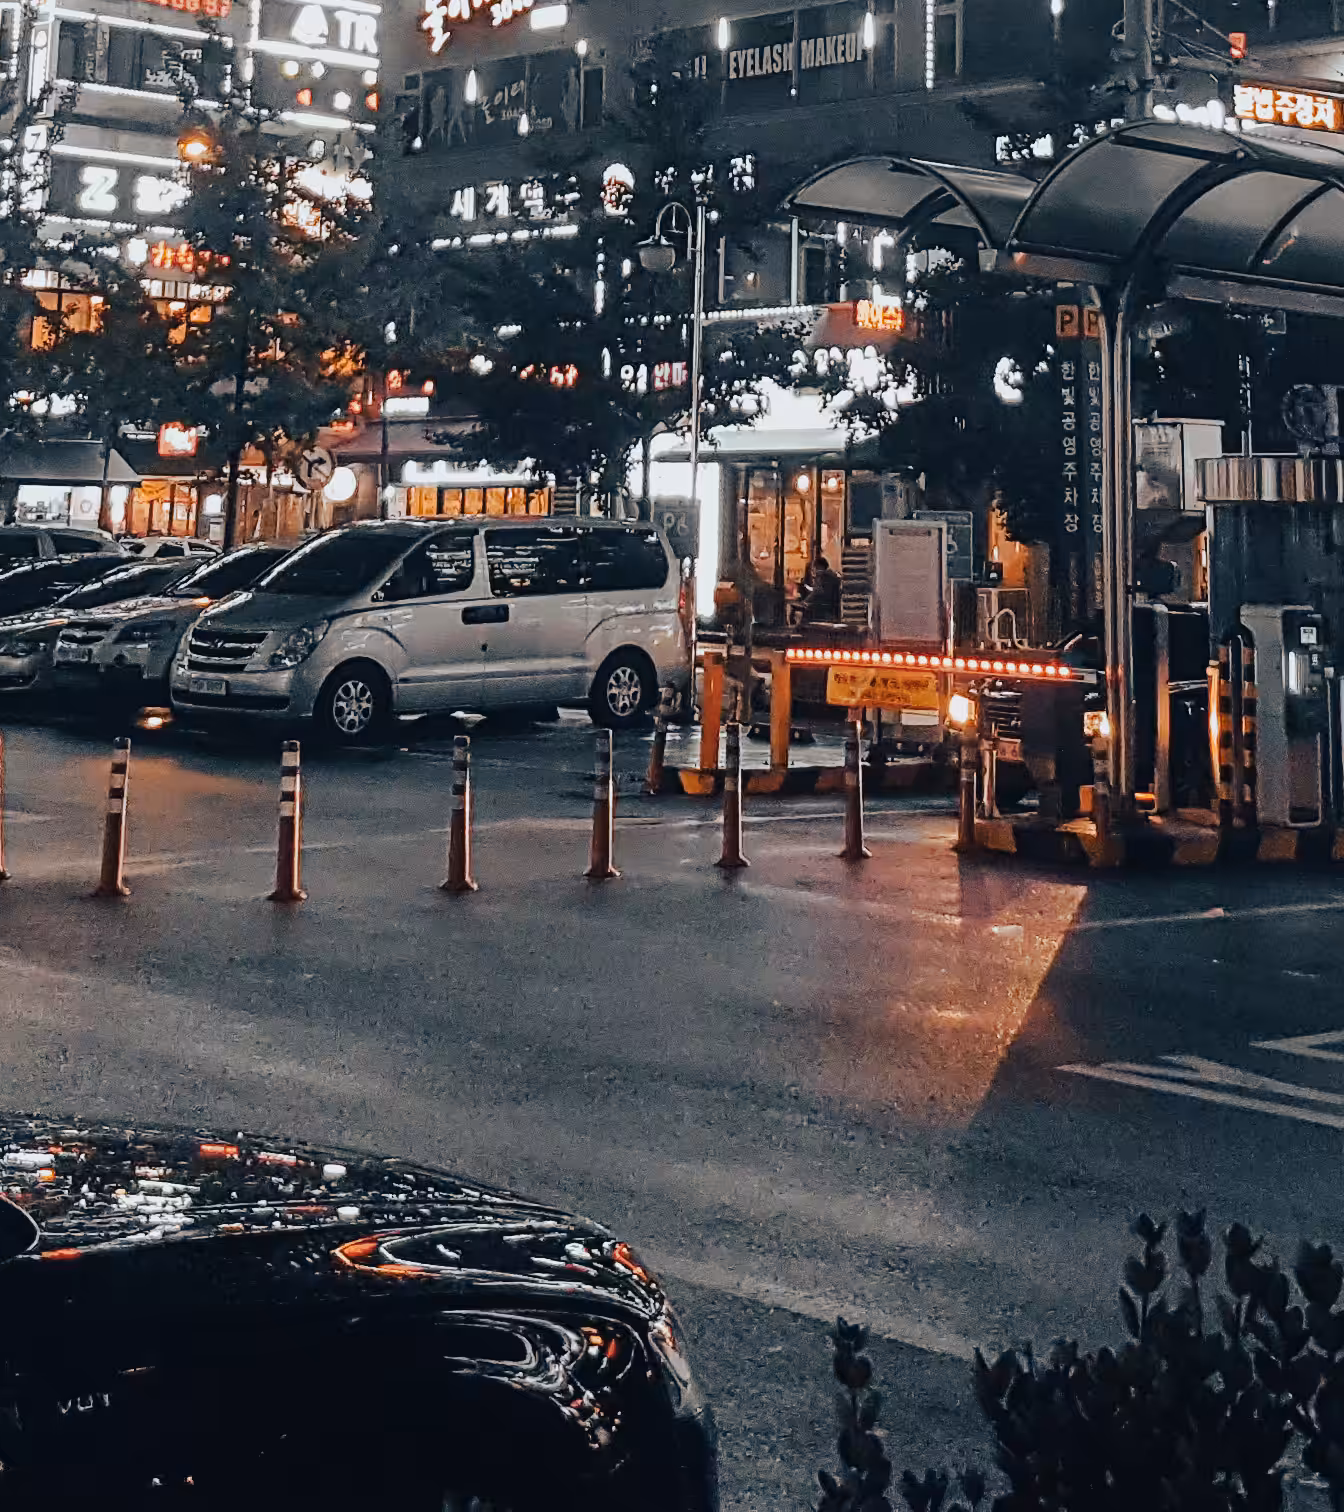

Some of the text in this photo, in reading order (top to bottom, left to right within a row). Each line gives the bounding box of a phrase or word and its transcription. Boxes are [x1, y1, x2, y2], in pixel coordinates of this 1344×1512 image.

[729, 44, 793, 80] EYELASH
[1233, 83, 1336, 131] 불법주정차
[1060, 359, 1081, 535] 한빛공영주차장
